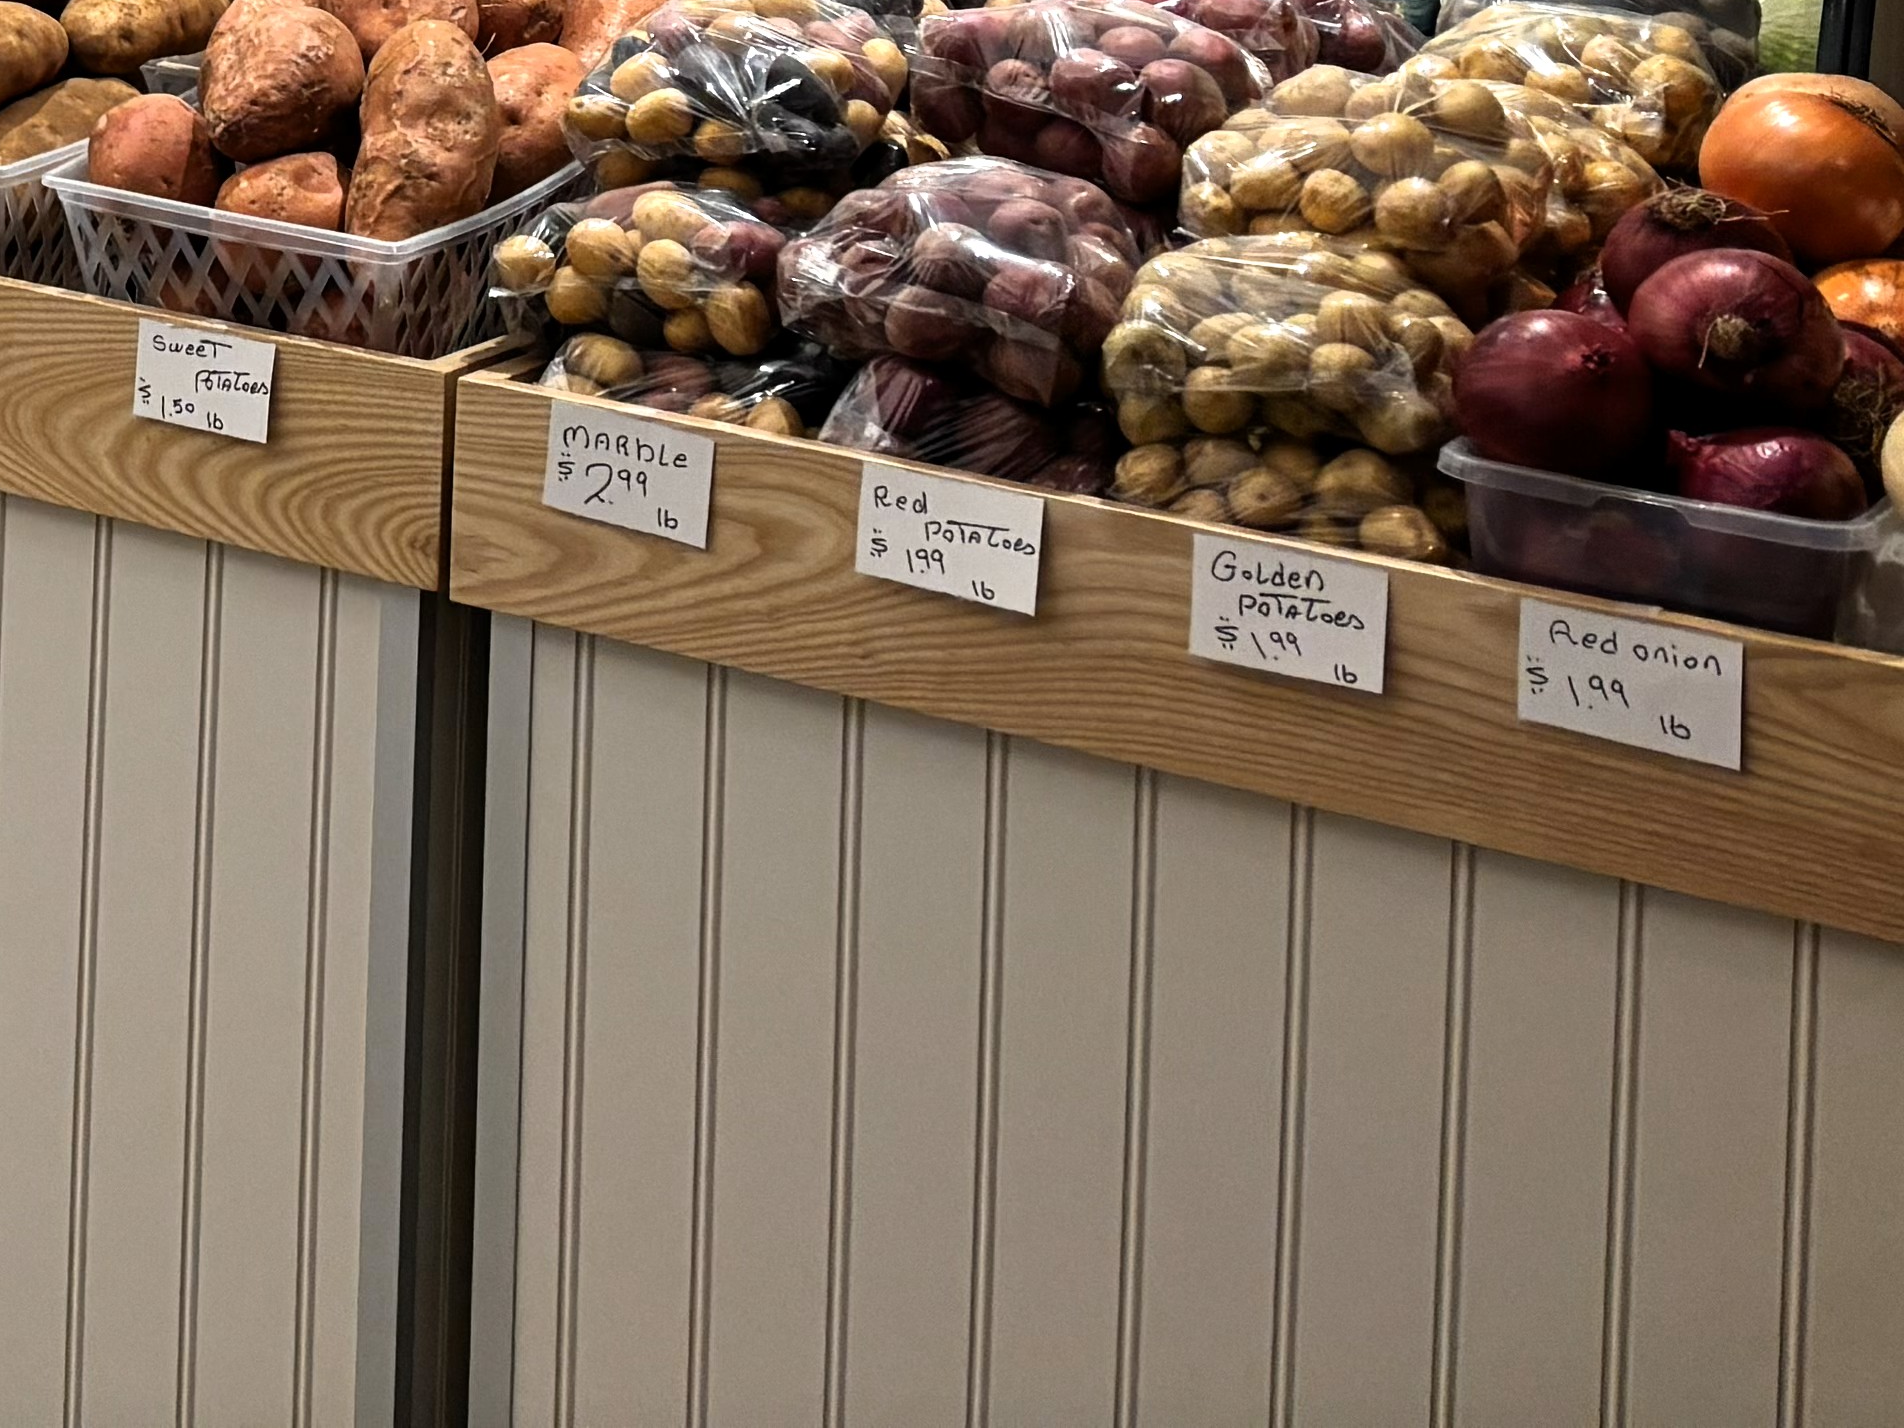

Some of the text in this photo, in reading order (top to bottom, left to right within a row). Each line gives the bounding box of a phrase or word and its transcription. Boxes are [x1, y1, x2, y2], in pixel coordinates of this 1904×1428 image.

[206, 411, 224, 431] lb
[873, 485, 929, 515] Red
[656, 507, 679, 531] lb
[972, 579, 995, 601] lb
[1549, 619, 1723, 677] Red onion
[1334, 662, 1358, 685] lb
[1659, 714, 1692, 741] lb
